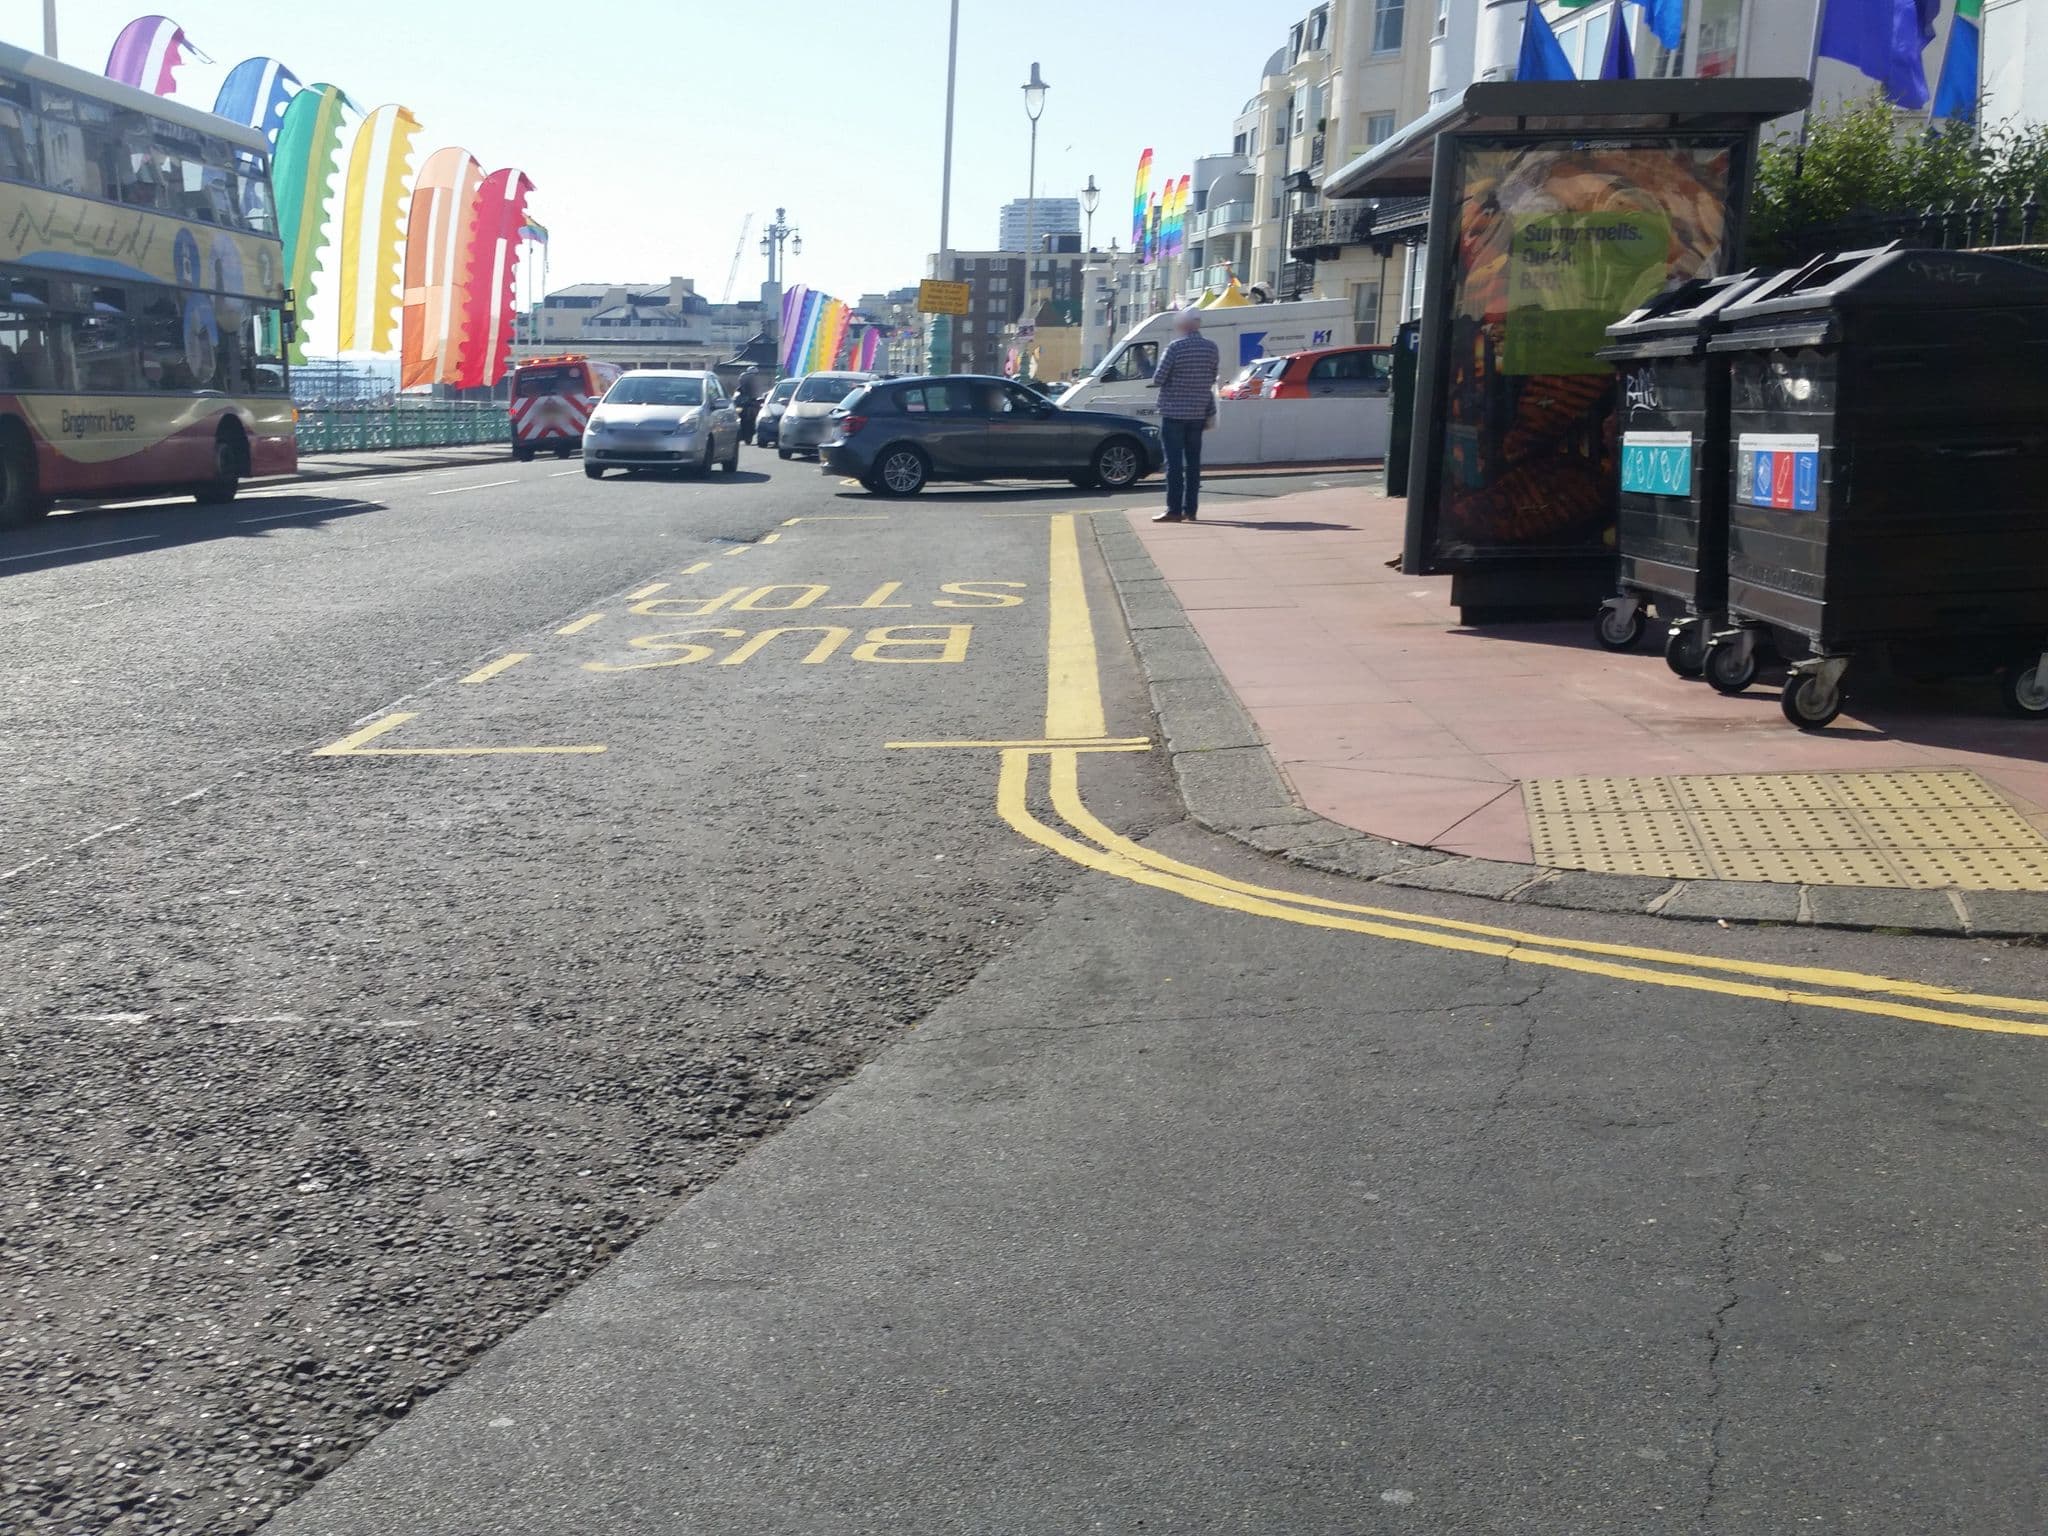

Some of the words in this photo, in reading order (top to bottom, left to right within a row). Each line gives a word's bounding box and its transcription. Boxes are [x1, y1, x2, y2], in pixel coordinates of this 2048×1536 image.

[1410, 332, 1420, 350] P
[631, 581, 1027, 616] STOP
[580, 623, 974, 672] BUS
